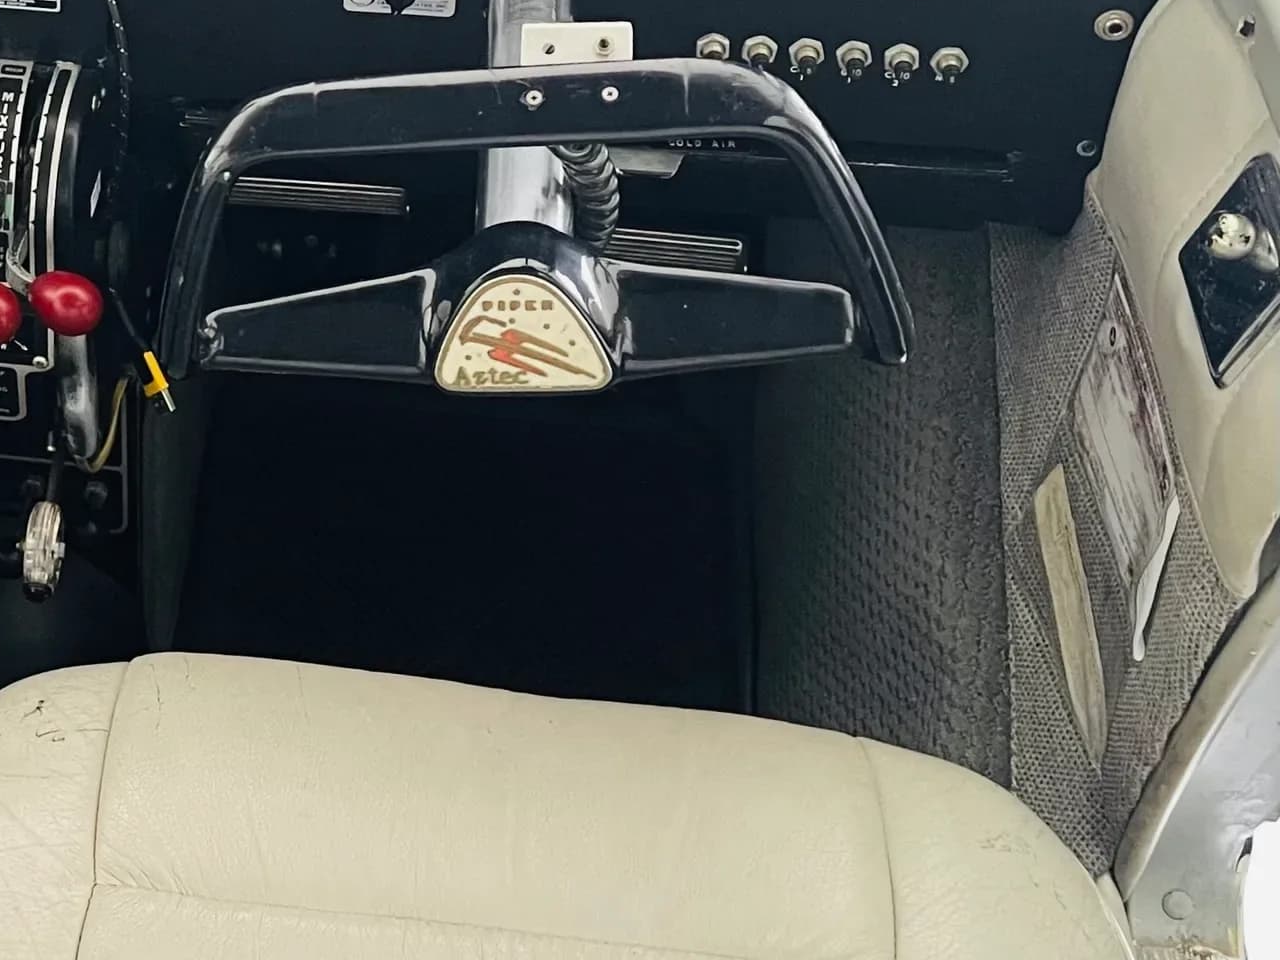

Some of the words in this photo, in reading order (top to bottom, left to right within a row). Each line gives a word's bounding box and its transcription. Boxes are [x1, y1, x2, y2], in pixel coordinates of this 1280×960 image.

[712, 139, 736, 148] AIR
[481, 300, 554, 312] PIPER
[453, 365, 530, 387] Aztec
